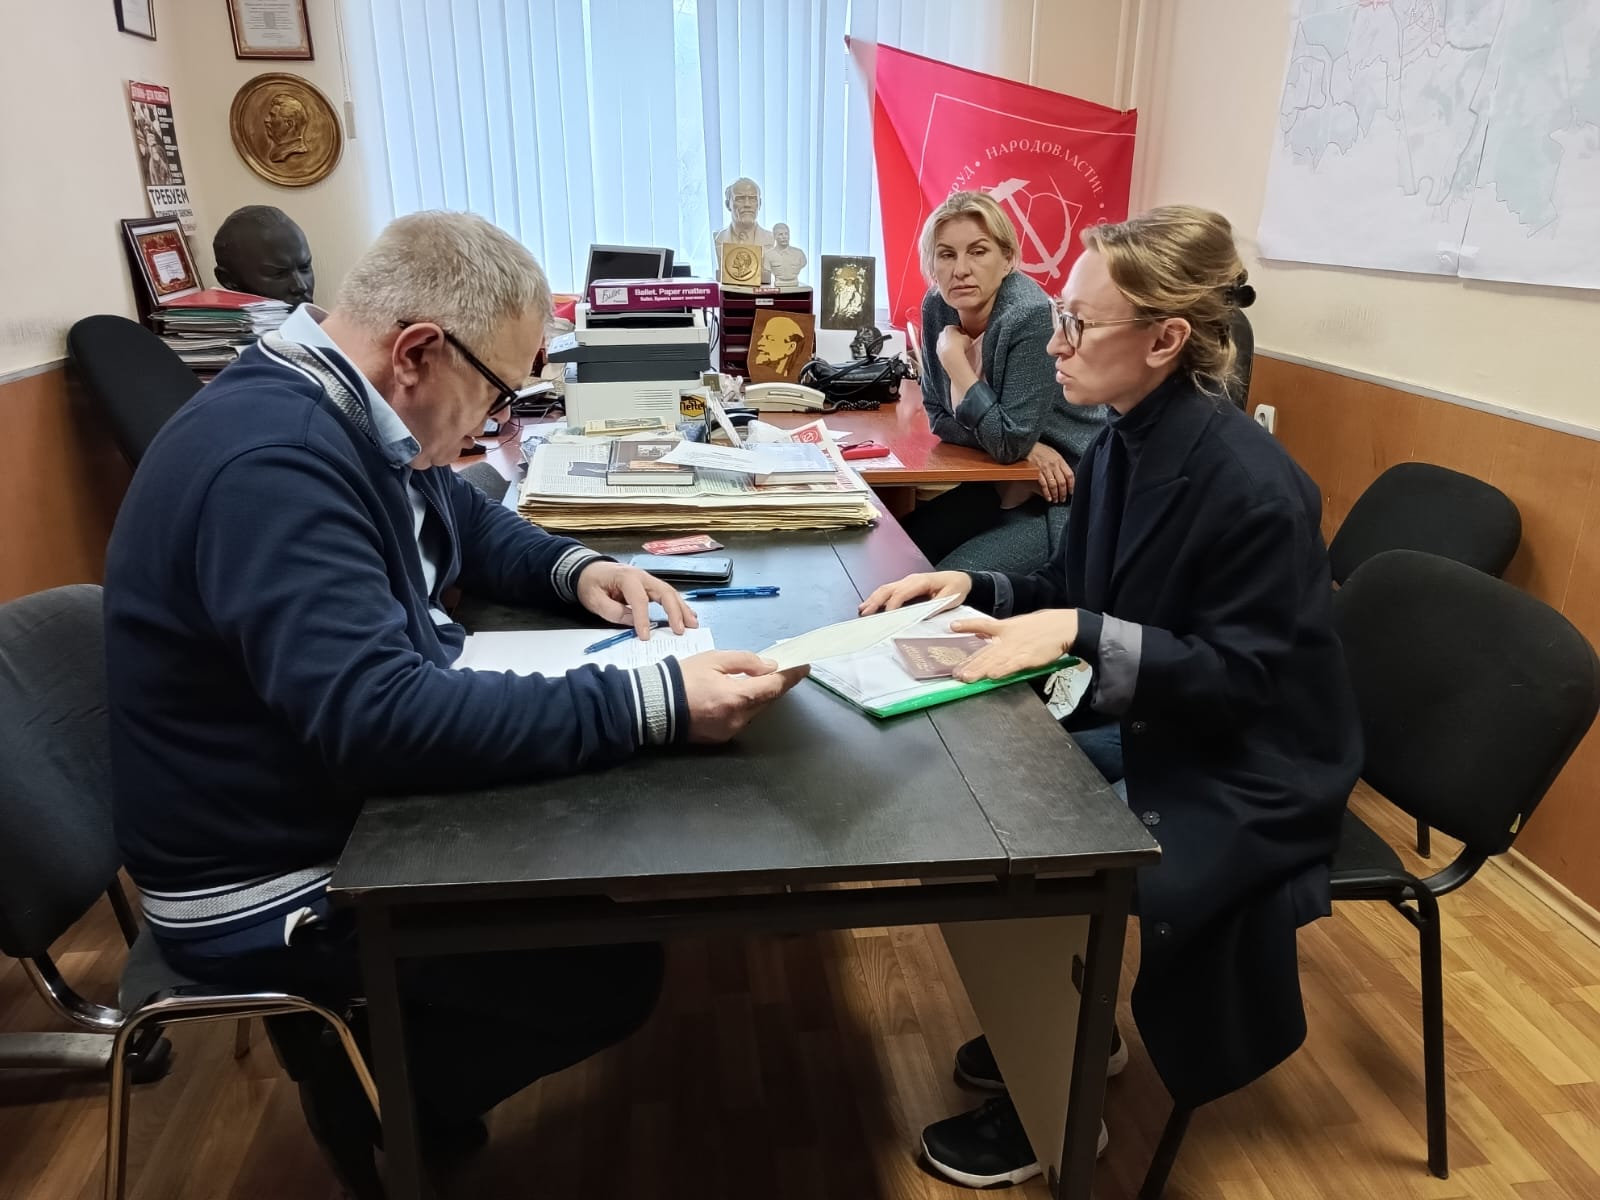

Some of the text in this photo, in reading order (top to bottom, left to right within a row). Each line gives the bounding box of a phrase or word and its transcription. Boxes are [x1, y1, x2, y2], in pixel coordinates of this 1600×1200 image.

[985, 138, 1104, 198] НАРОДОВЛАСТИЕ
[148, 188, 190, 205] ТРЕБУЕМ
[659, 287, 681, 298] Paper
[682, 287, 711, 295] matters
